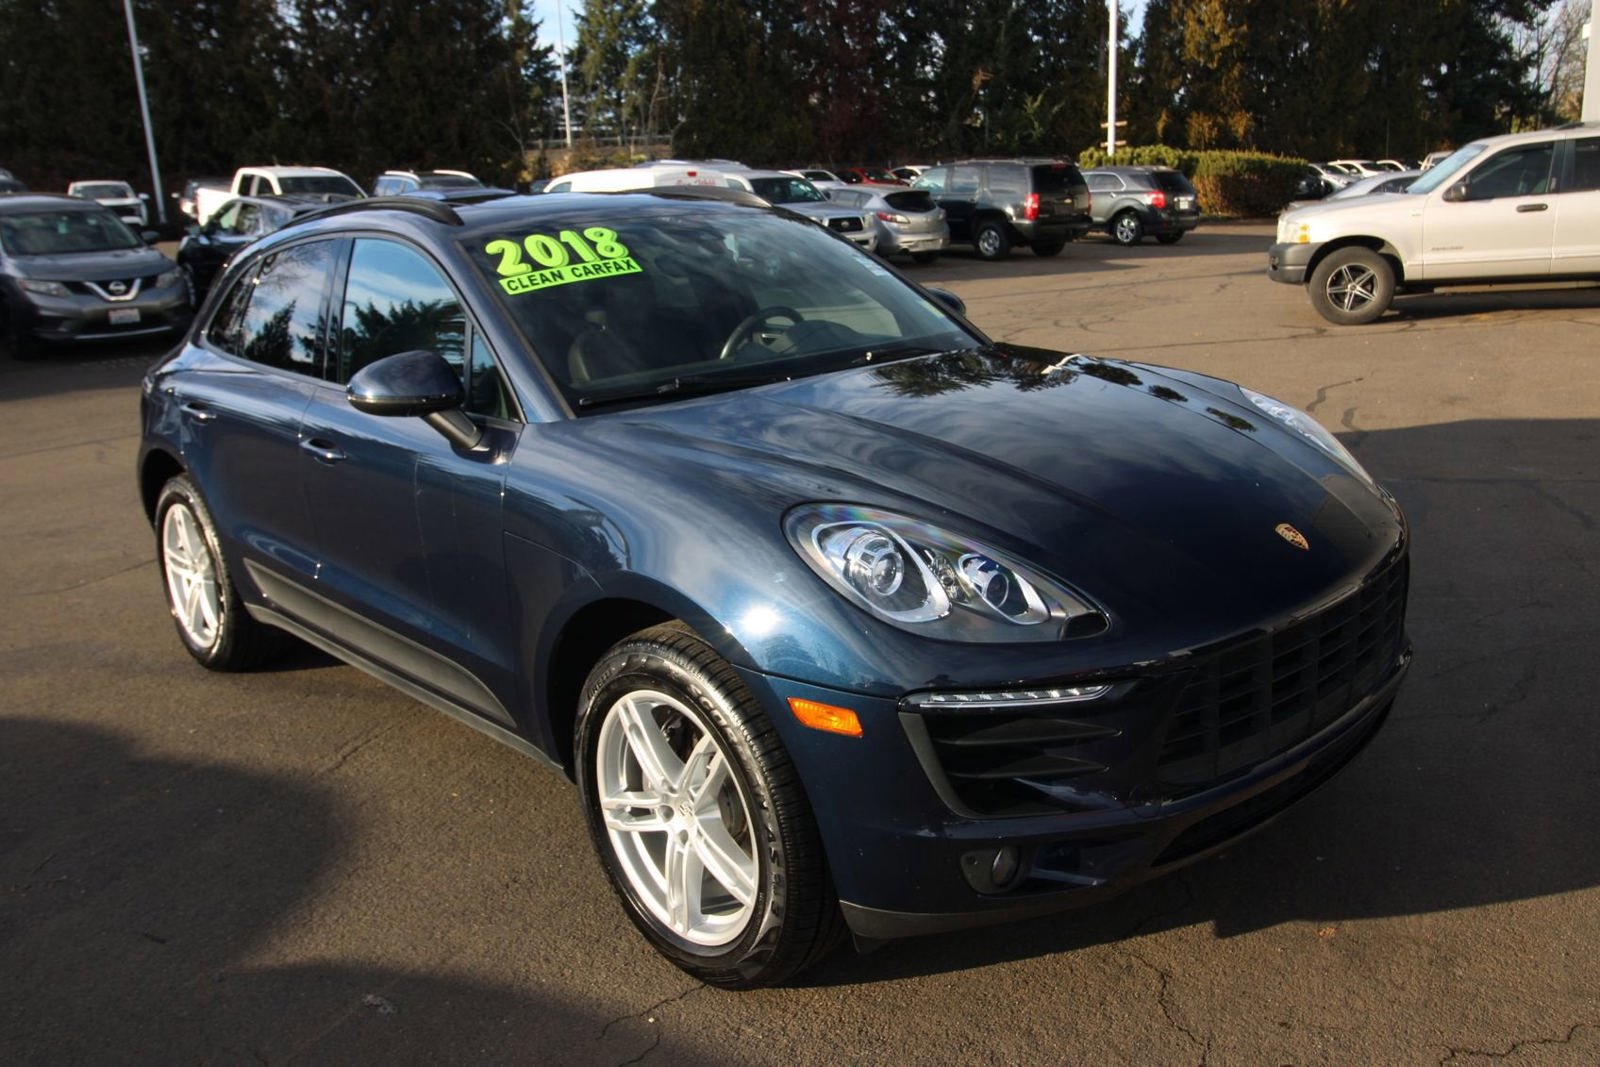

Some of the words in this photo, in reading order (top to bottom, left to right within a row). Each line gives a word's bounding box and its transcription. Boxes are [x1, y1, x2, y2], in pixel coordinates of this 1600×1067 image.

[485, 227, 629, 277] 2018
[506, 270, 565, 292] CLEAN
[571, 259, 637, 278] CARFAX
